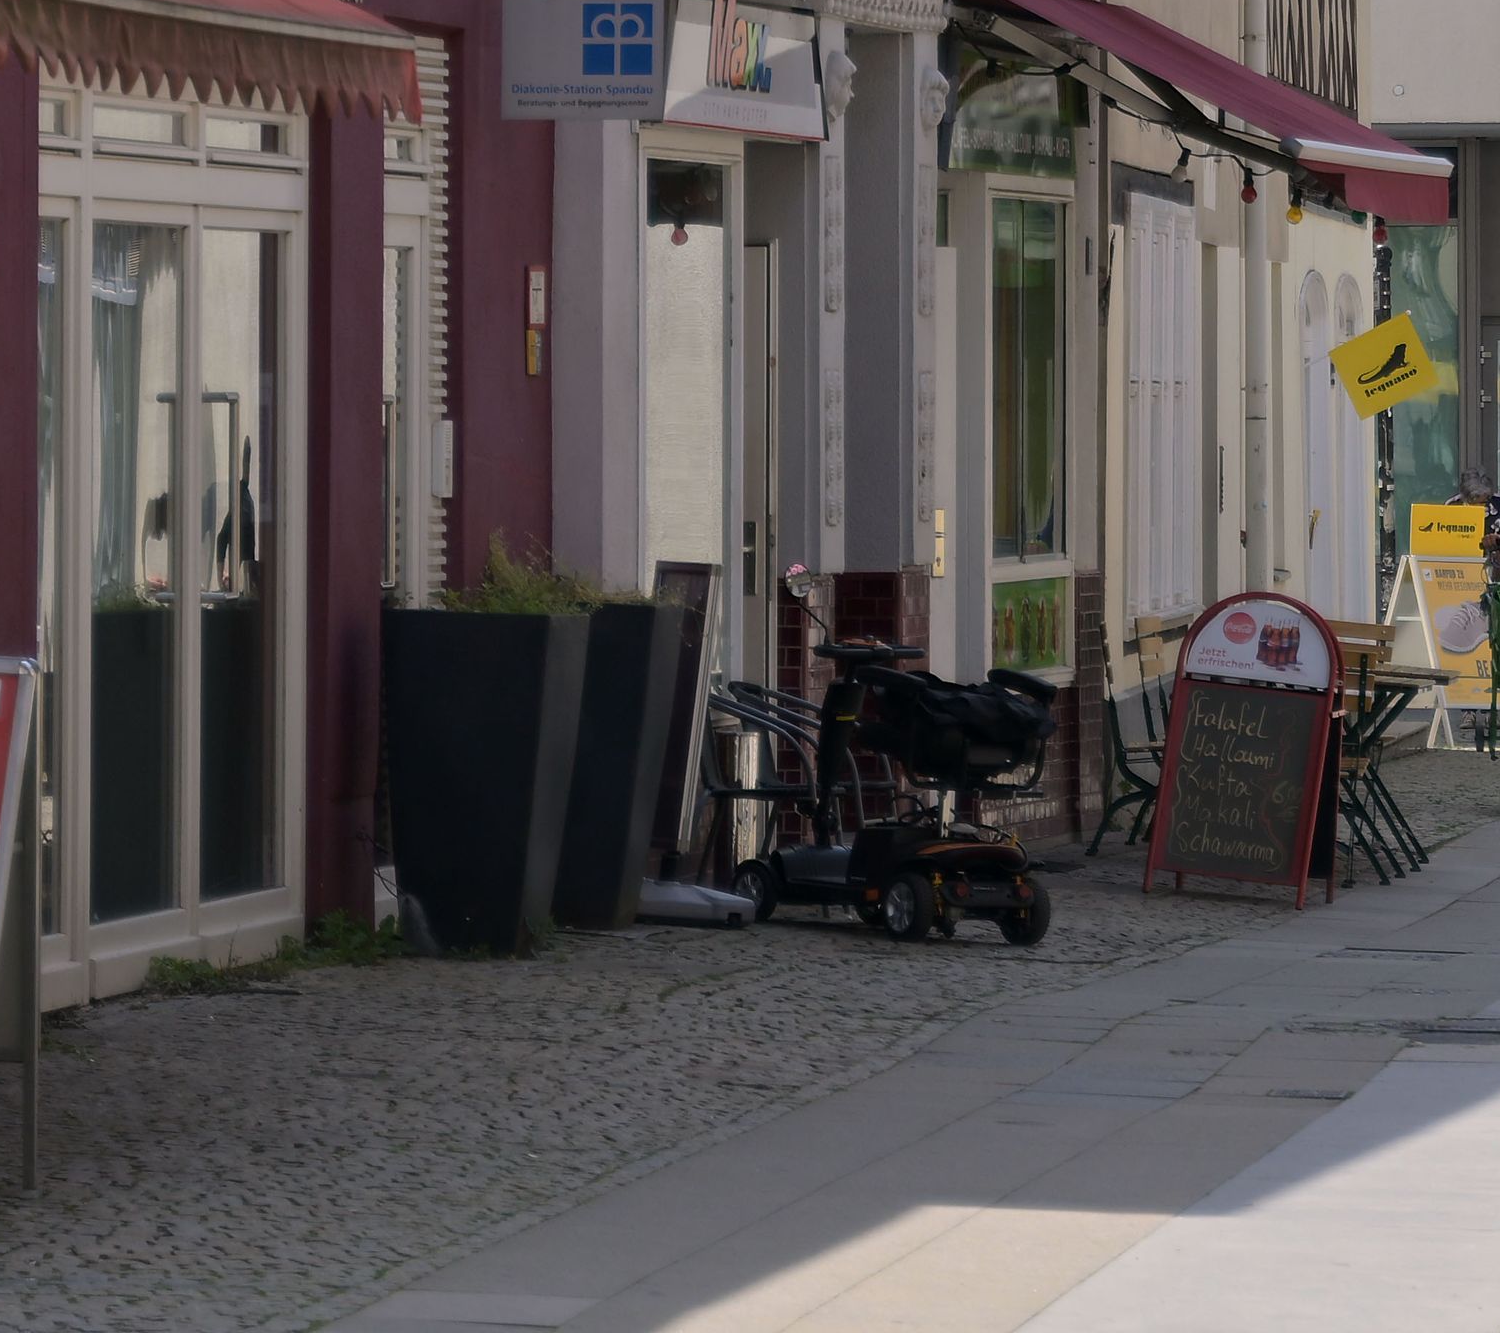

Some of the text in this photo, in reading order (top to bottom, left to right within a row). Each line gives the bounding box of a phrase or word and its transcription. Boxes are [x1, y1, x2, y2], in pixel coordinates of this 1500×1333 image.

[511, 84, 654, 97] Diakonie-Station Spandau
[517, 99, 649, 110] Beratungs- und Begegnungscenter
[1199, 647, 1227, 658] Jetzt
[1197, 657, 1255, 671] erfrischen!
[1194, 696, 1269, 739] Falafel
